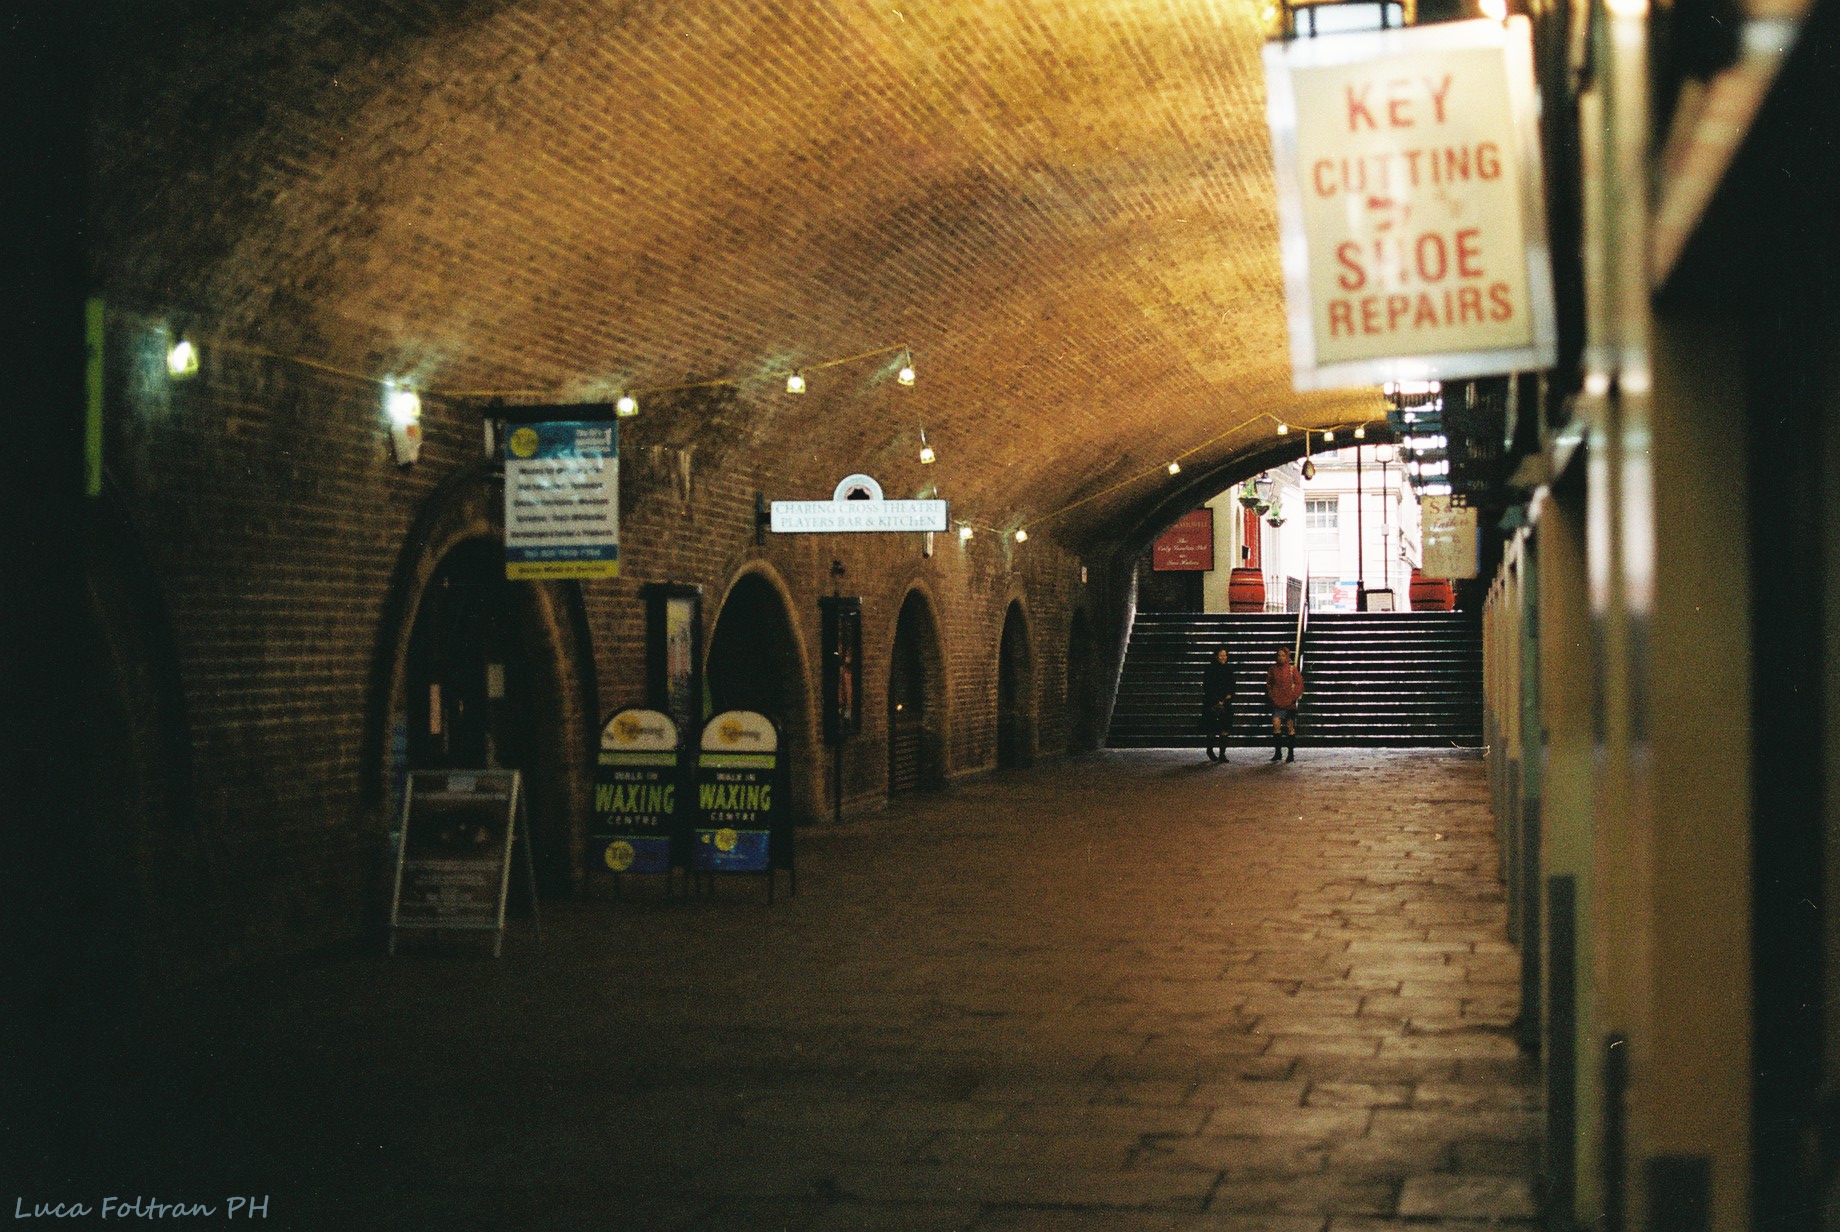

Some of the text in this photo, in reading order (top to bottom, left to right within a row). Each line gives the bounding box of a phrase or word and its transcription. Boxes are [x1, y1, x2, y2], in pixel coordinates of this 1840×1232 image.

[1345, 74, 1453, 133] KEY
[1312, 141, 1502, 198] CUTTING
[1327, 281, 1514, 340] REPAIRS
[775, 501, 944, 515] CHARING CROSS THEATRE
[781, 516, 835, 528] PLAYERS
[838, 516, 863, 527] BAR
[865, 517, 875, 527] &
[595, 783, 675, 815] WAXING
[700, 784, 771, 812] WAXING
[607, 815, 658, 826] CENTRE
[710, 812, 756, 822] CENTRE
